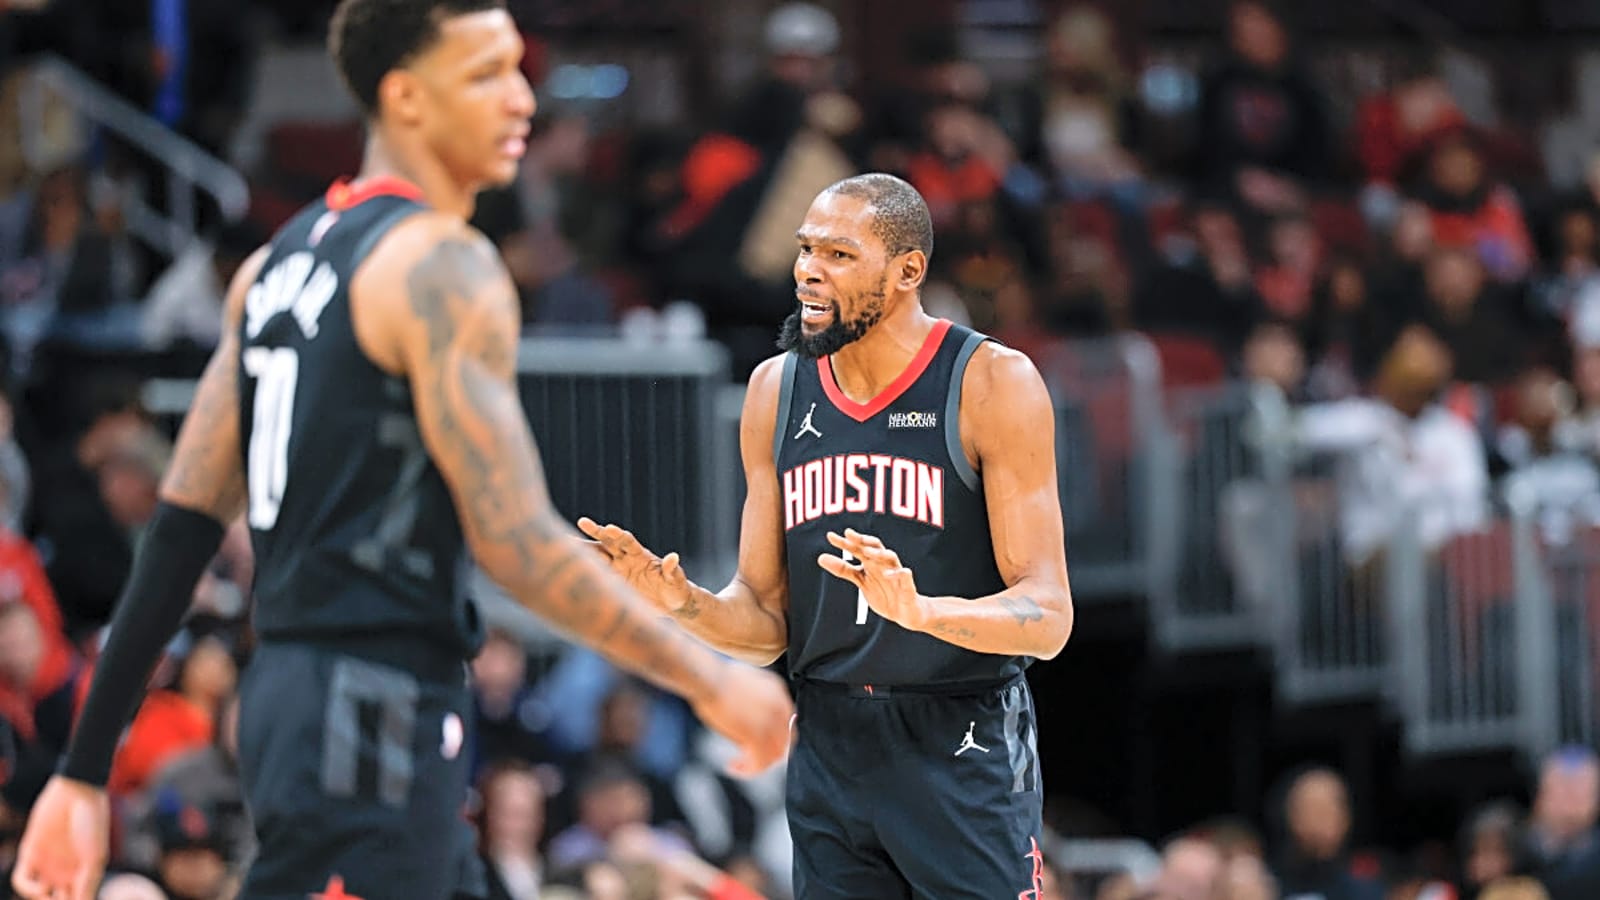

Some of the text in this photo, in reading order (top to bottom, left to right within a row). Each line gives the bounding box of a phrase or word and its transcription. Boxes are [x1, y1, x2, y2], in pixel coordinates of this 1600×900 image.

[889, 411, 936, 421] MEMORIAL
[888, 419, 936, 428] HERMANN
[783, 453, 945, 531] HOUSTON
